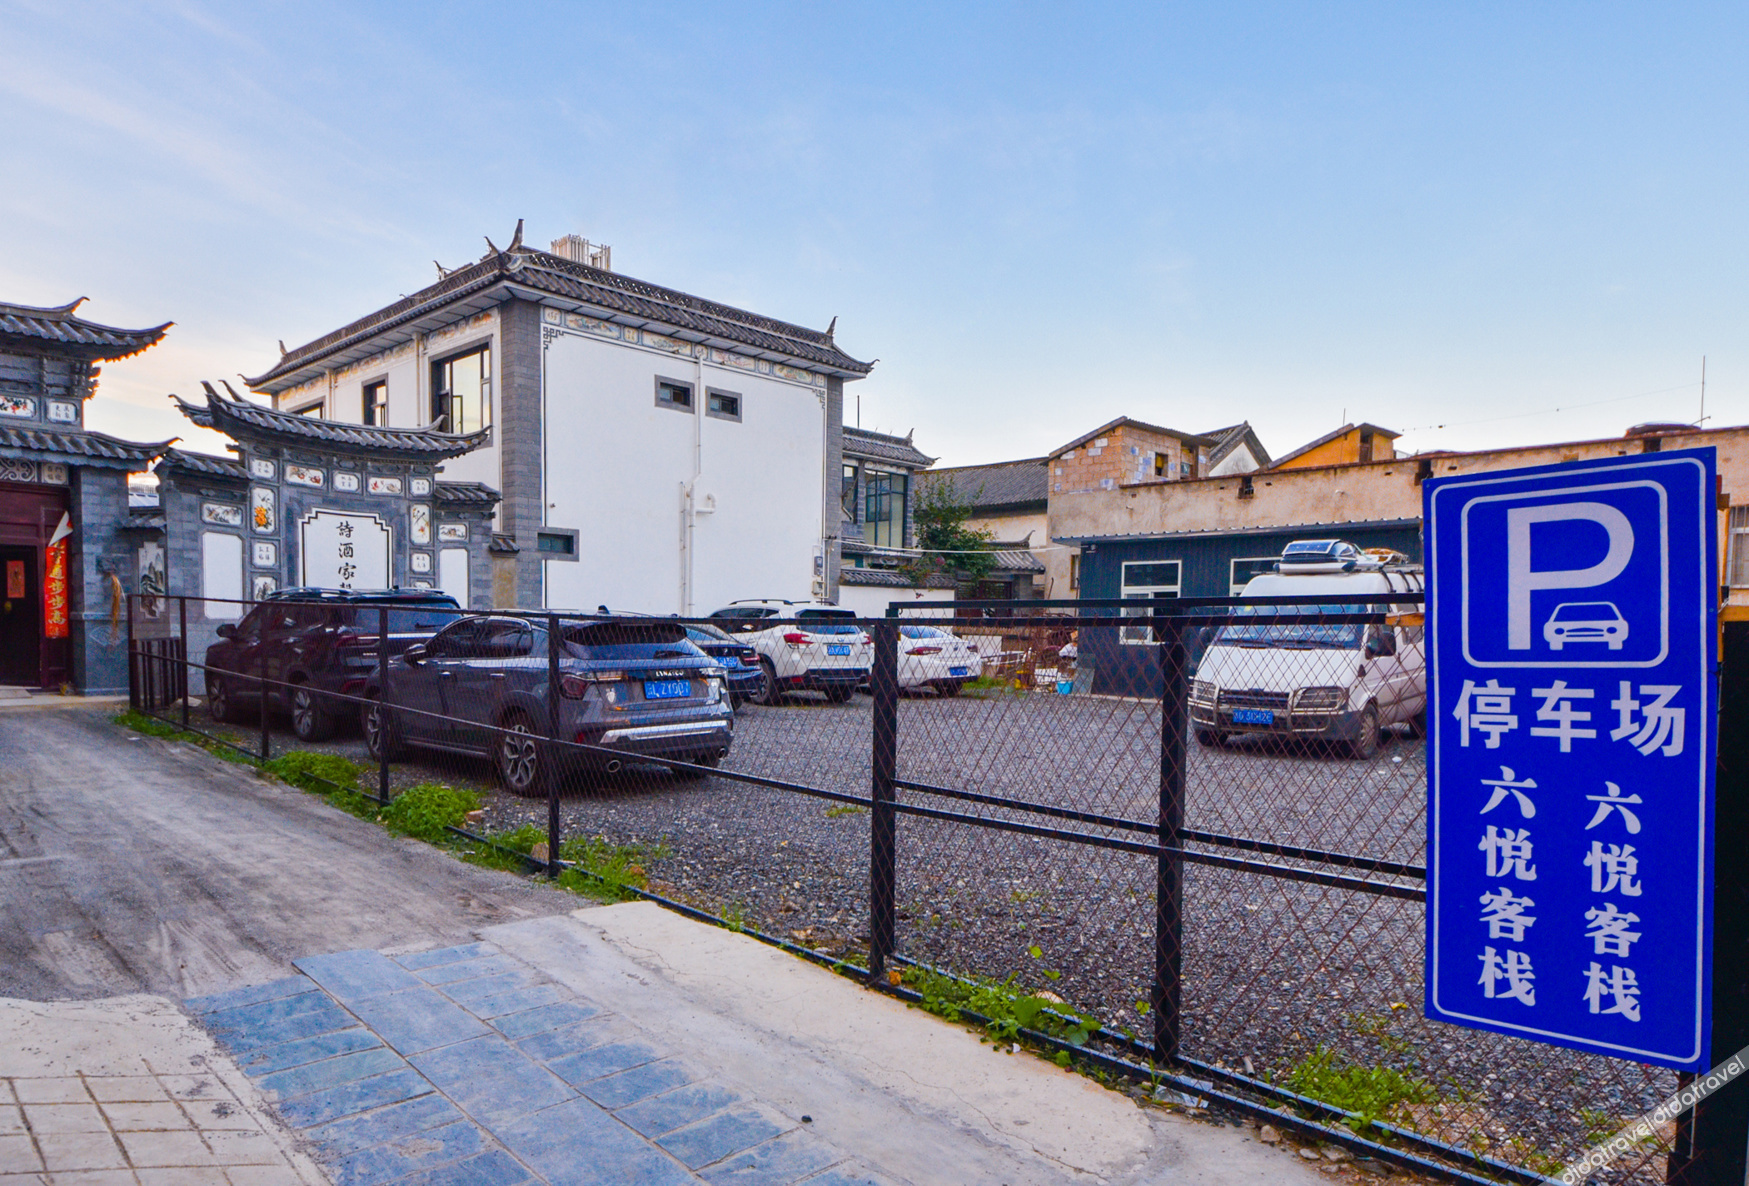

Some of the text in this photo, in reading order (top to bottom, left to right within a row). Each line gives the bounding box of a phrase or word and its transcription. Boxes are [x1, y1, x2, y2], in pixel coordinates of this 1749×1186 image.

[1507, 501, 1635, 651] P
[1452, 679, 1686, 757] 停车场
[1478, 765, 1538, 1007] 六悦客栈
[1582, 781, 1643, 1023] 六悦客栈
